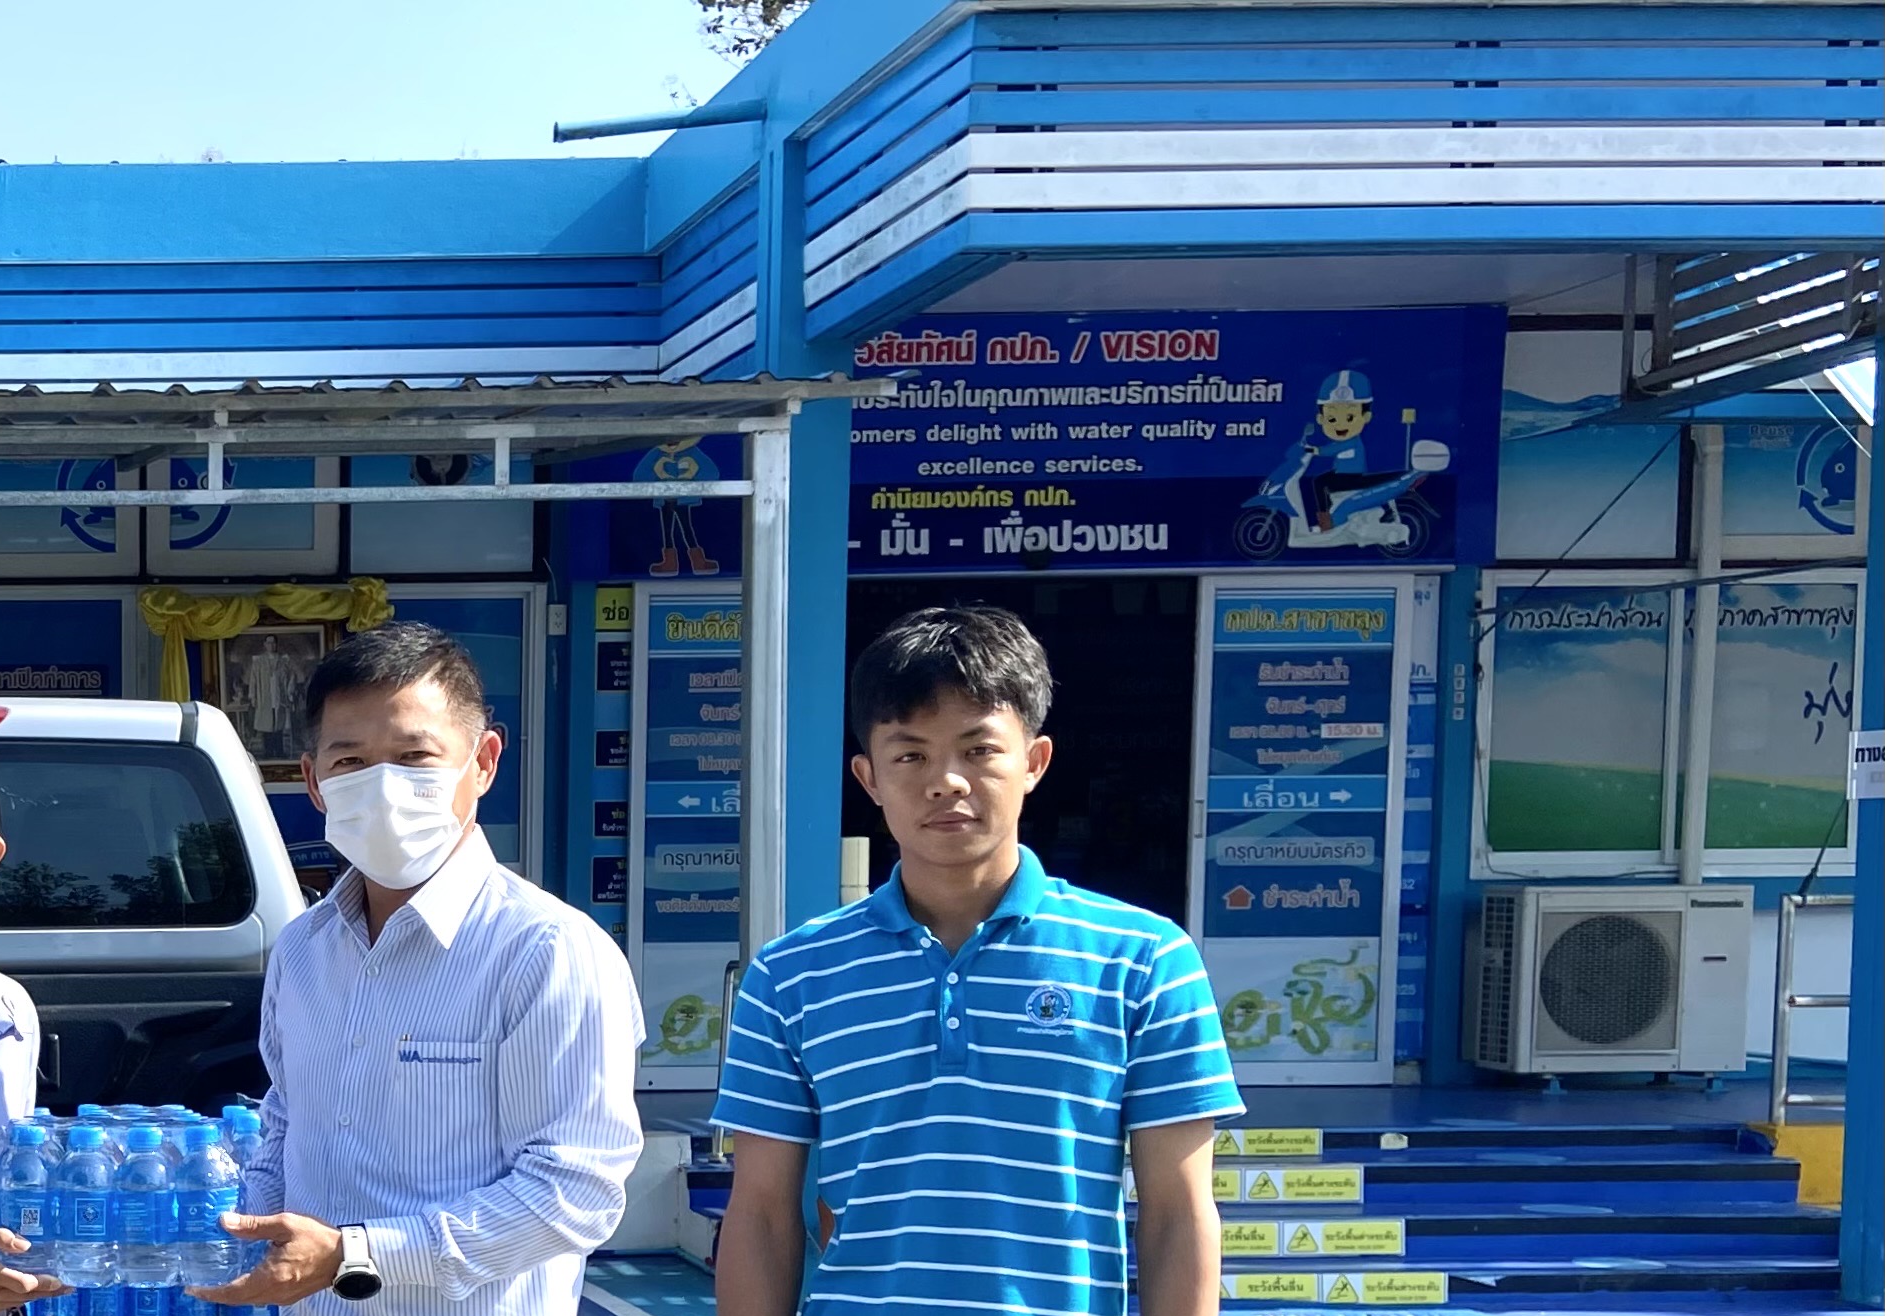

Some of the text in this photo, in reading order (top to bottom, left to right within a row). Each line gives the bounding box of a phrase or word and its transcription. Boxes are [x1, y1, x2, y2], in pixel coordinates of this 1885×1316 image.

[1100, 329, 1219, 362] VISION
[850, 417, 1266, 445] omers delight with water quality and
[917, 455, 1144, 477] excellence services.
[879, 512, 930, 557] มั่น
[983, 510, 1169, 554] เพื่อปวงชน
[1243, 780, 1319, 808] เลื่อน
